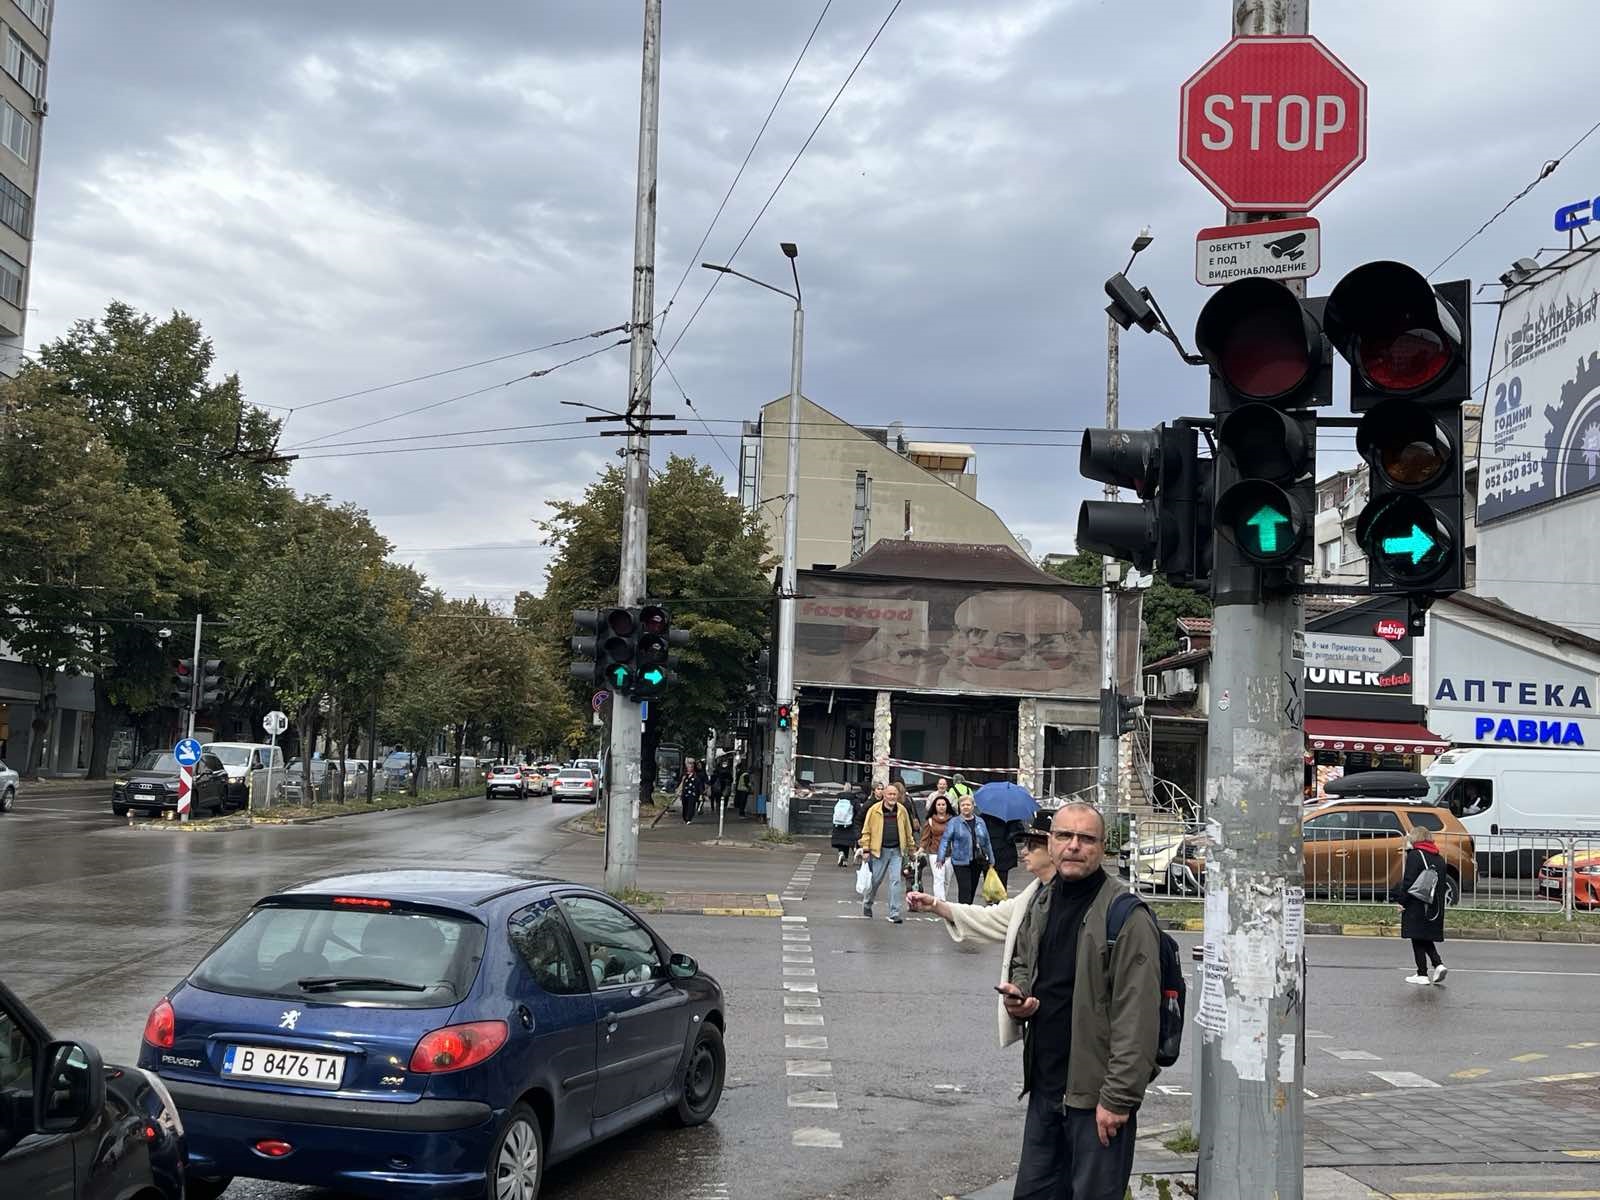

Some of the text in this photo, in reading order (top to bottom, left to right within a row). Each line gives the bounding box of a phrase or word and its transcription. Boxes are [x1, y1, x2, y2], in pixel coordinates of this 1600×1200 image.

[1201, 94, 1346, 151] STOP
[1555, 195, 1600, 232] C
[1209, 241, 1251, 253] ОБЕКТЪТ
[1209, 255, 1237, 265] Е ПОД
[1208, 263, 1307, 279] ВИДЕОНАБЛЮДЕНИЕ
[1495, 376, 1522, 417] 20
[1494, 405, 1532, 433] ГОДИНИ
[1485, 461, 1538, 489] 052 630 830
[1331, 642, 1366, 653] Приморски
[1435, 677, 1592, 709] АПТЕКА
[1475, 717, 1584, 746] РАВИА
[162, 1055, 201, 1068] PEUGEOT
[241, 1051, 337, 1080] B 8476 TA
